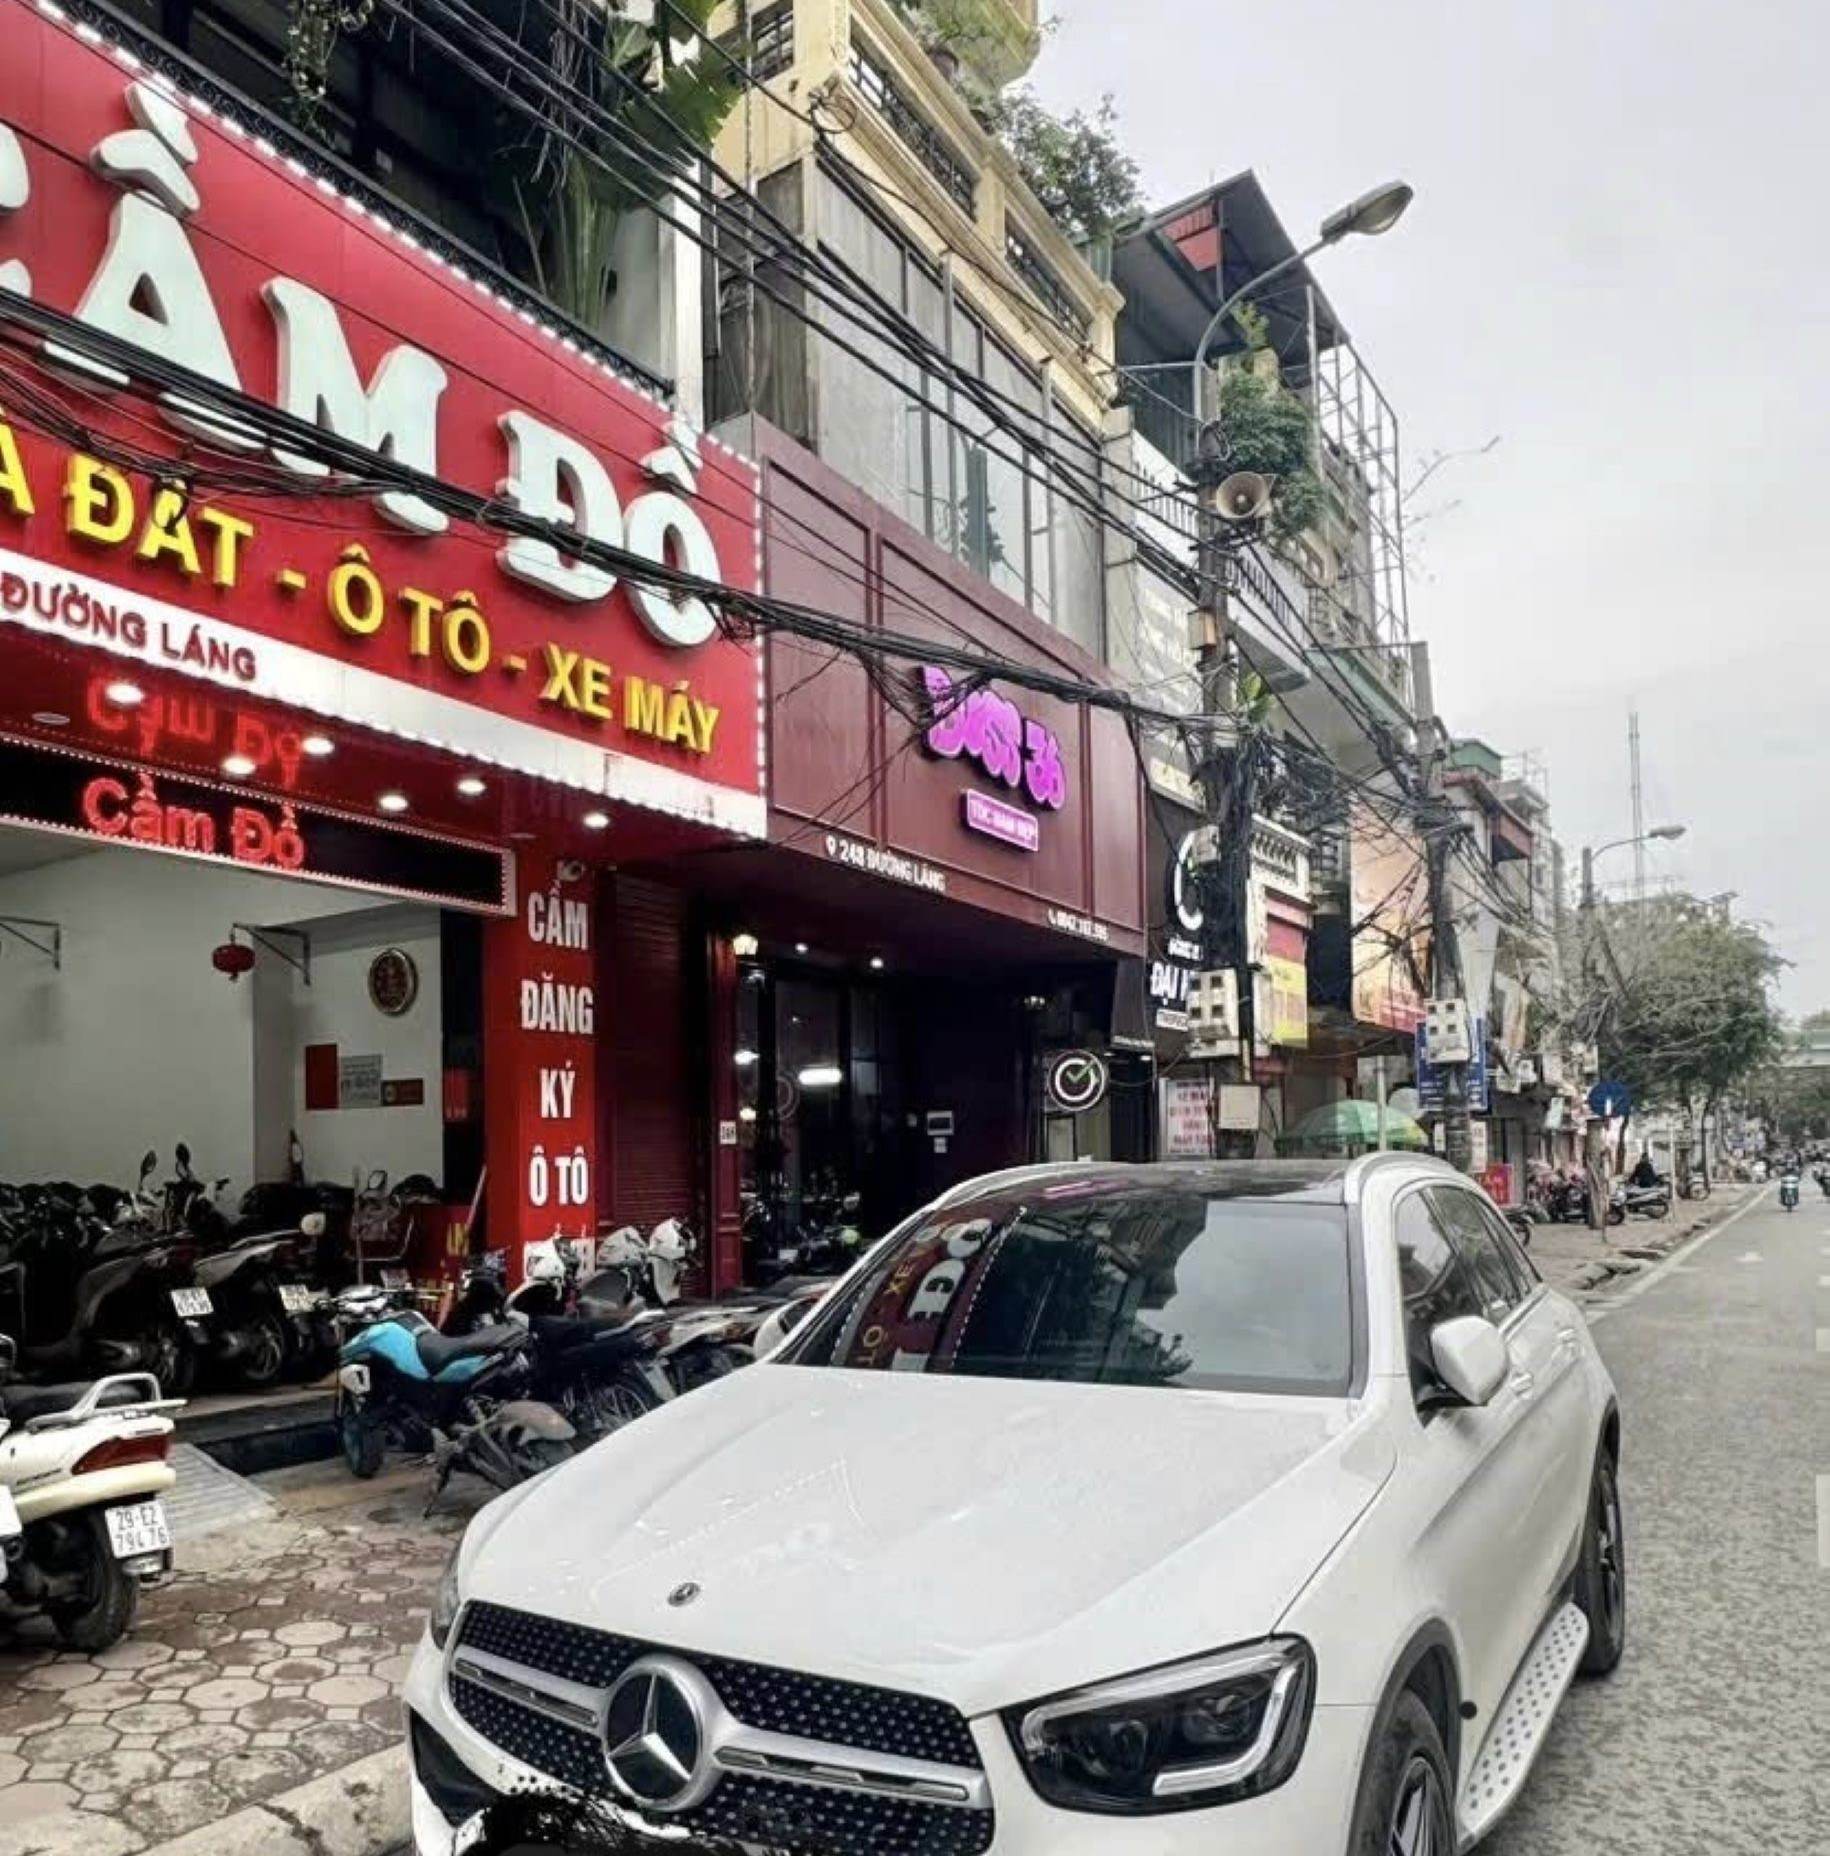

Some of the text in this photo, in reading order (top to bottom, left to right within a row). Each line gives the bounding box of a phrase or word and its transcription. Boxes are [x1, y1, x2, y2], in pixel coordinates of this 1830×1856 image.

[495, 410, 722, 648] ĐỒ
[160, 622, 257, 681] LÁNG
[327, 543, 384, 634] Ô
[399, 589, 490, 673] TÔ
[539, 641, 613, 720] XE
[624, 680, 720, 754] MÁY
[82, 768, 305, 868] Cầm Đồ
[520, 971, 595, 1035] ĐĂNG
[539, 1060, 577, 1119] KÝ
[528, 1144, 590, 1207] Ô TÔ
